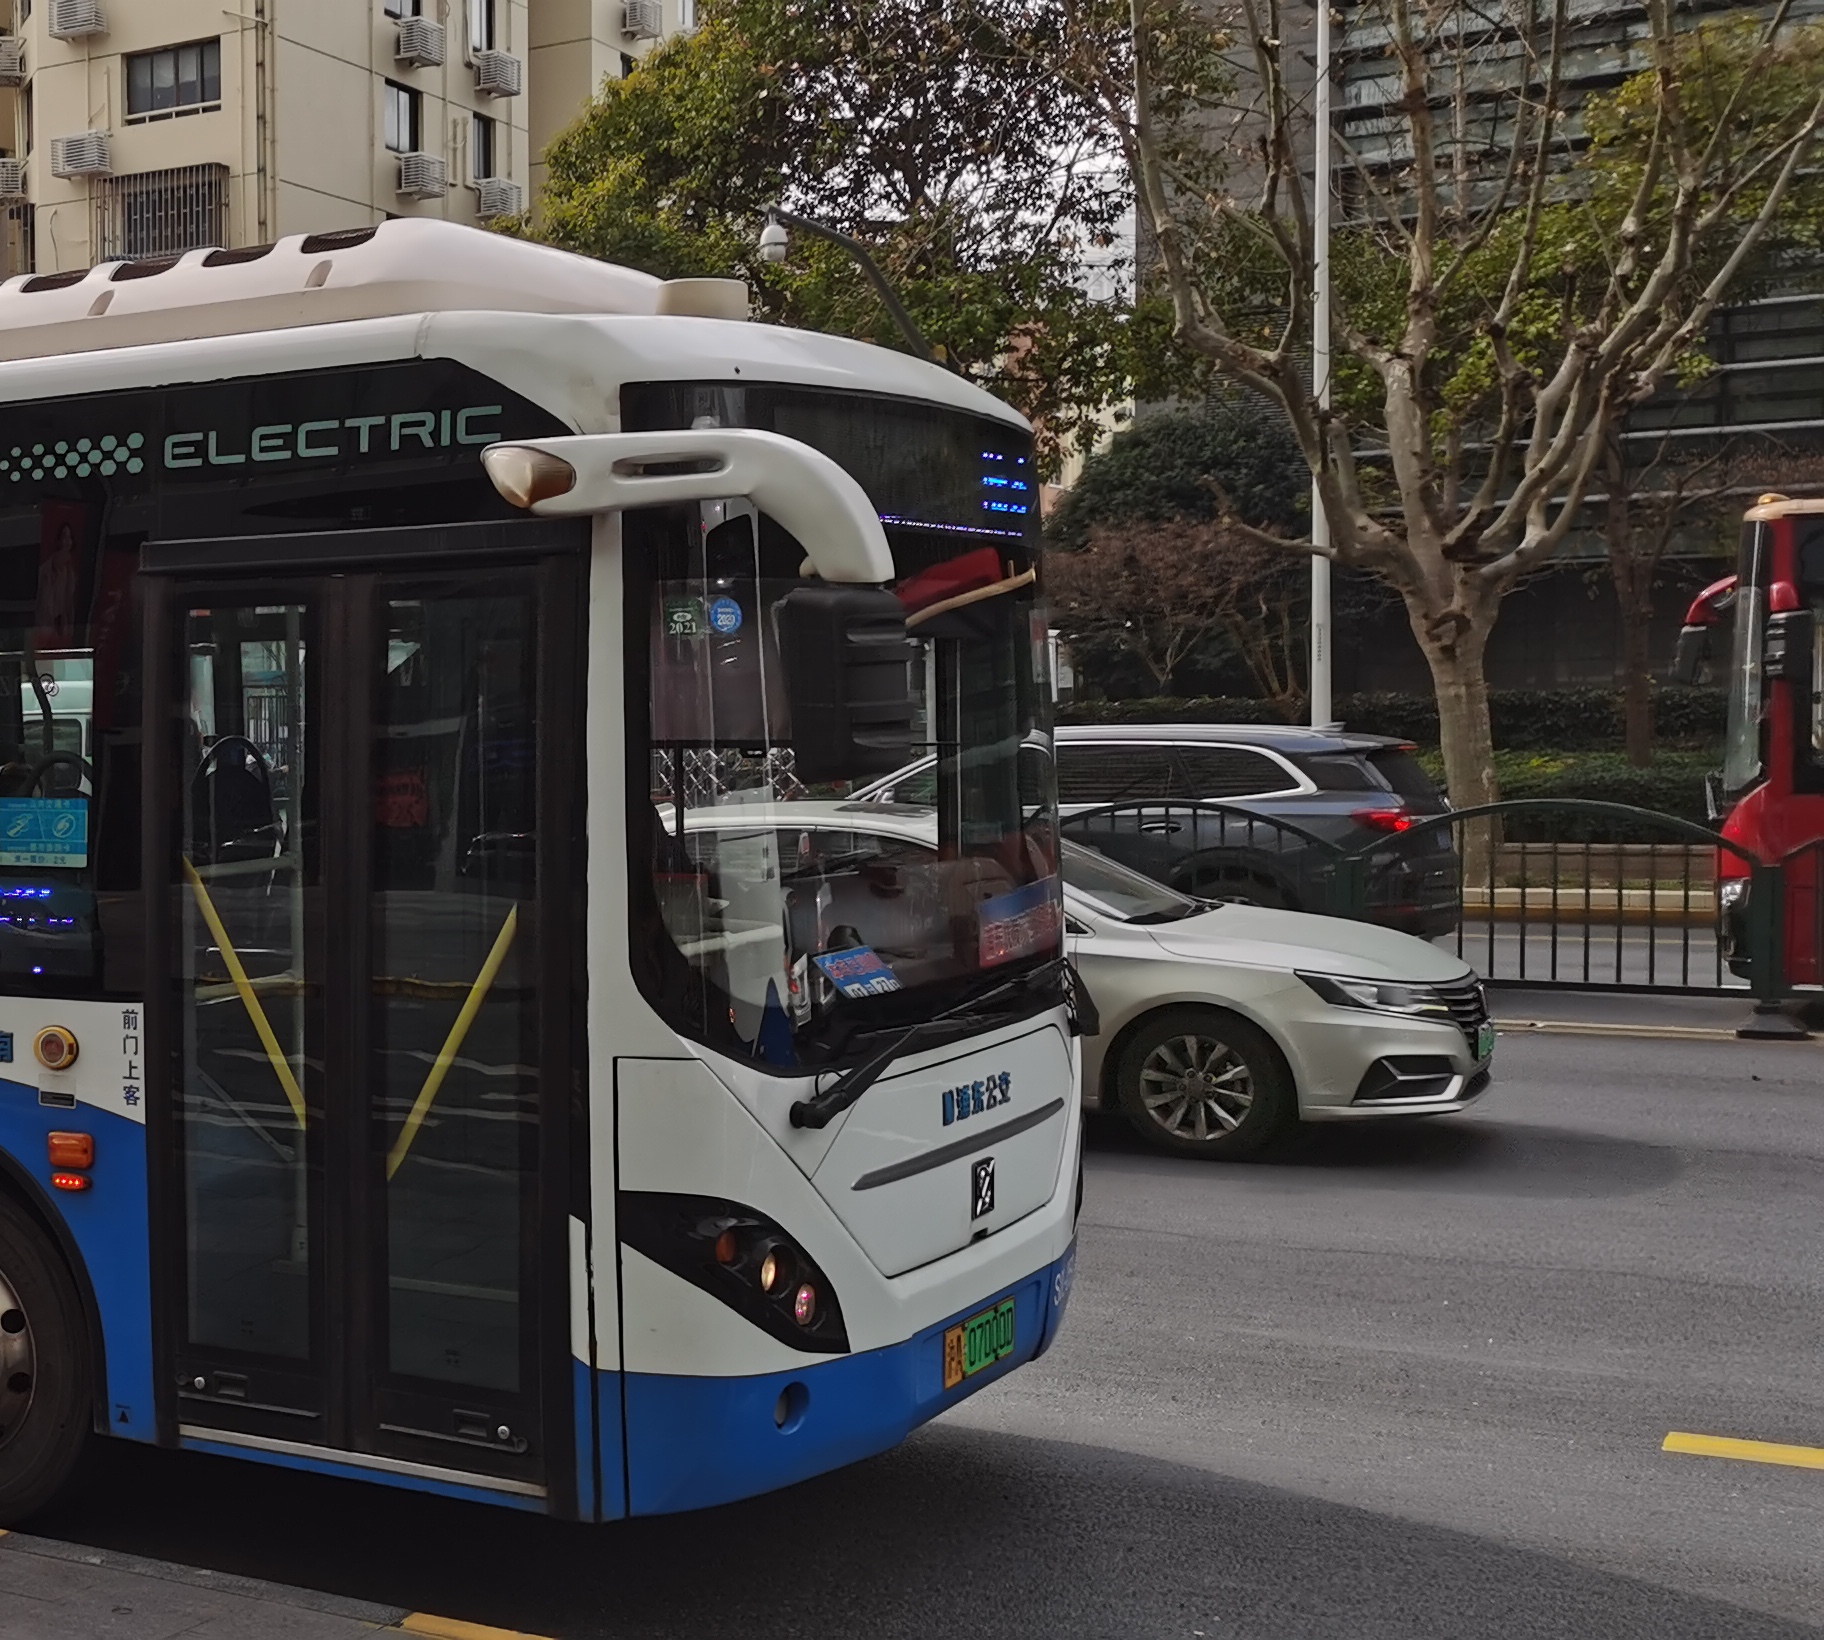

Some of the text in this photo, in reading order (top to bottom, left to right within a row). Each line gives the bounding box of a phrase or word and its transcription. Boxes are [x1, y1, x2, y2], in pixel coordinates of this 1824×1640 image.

[163, 405, 502, 468] ELECTRIC
[669, 621, 697, 635] 2021
[121, 1008, 141, 1107] 前门上客
